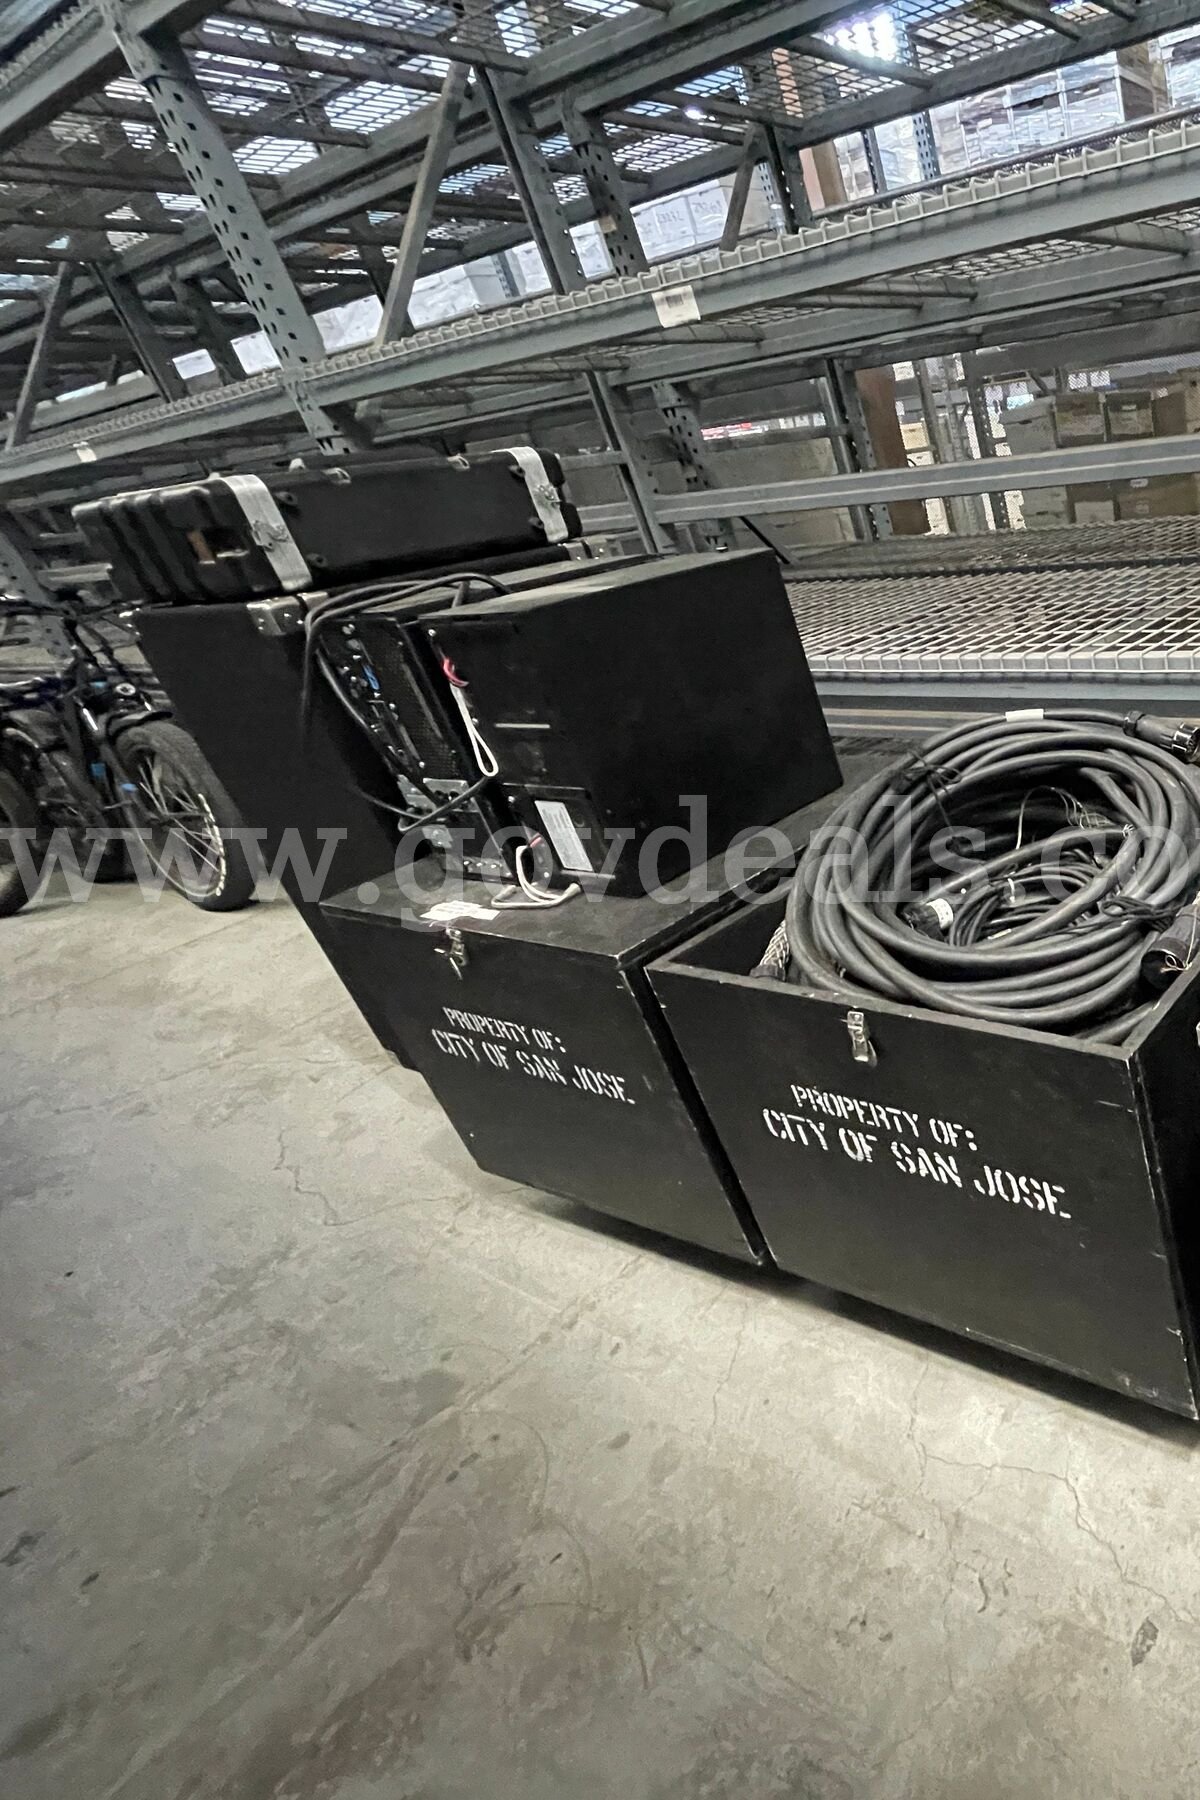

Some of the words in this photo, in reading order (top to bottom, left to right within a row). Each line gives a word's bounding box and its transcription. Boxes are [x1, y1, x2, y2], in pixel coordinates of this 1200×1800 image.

[442, 1006, 530, 1045] PROPERTY
[532, 1028, 566, 1053] OF:
[431, 1029, 480, 1062] CITY
[482, 1041, 509, 1070] OF
[515, 1050, 568, 1085] SAN
[572, 1065, 635, 1104] JOSE
[790, 1084, 920, 1138] PROPERTY
[929, 1118, 978, 1151] OF:
[763, 1109, 828, 1150] CITY
[838, 1127, 877, 1163] OF
[890, 1141, 963, 1188] SAN
[973, 1165, 1072, 1219] JOSE
